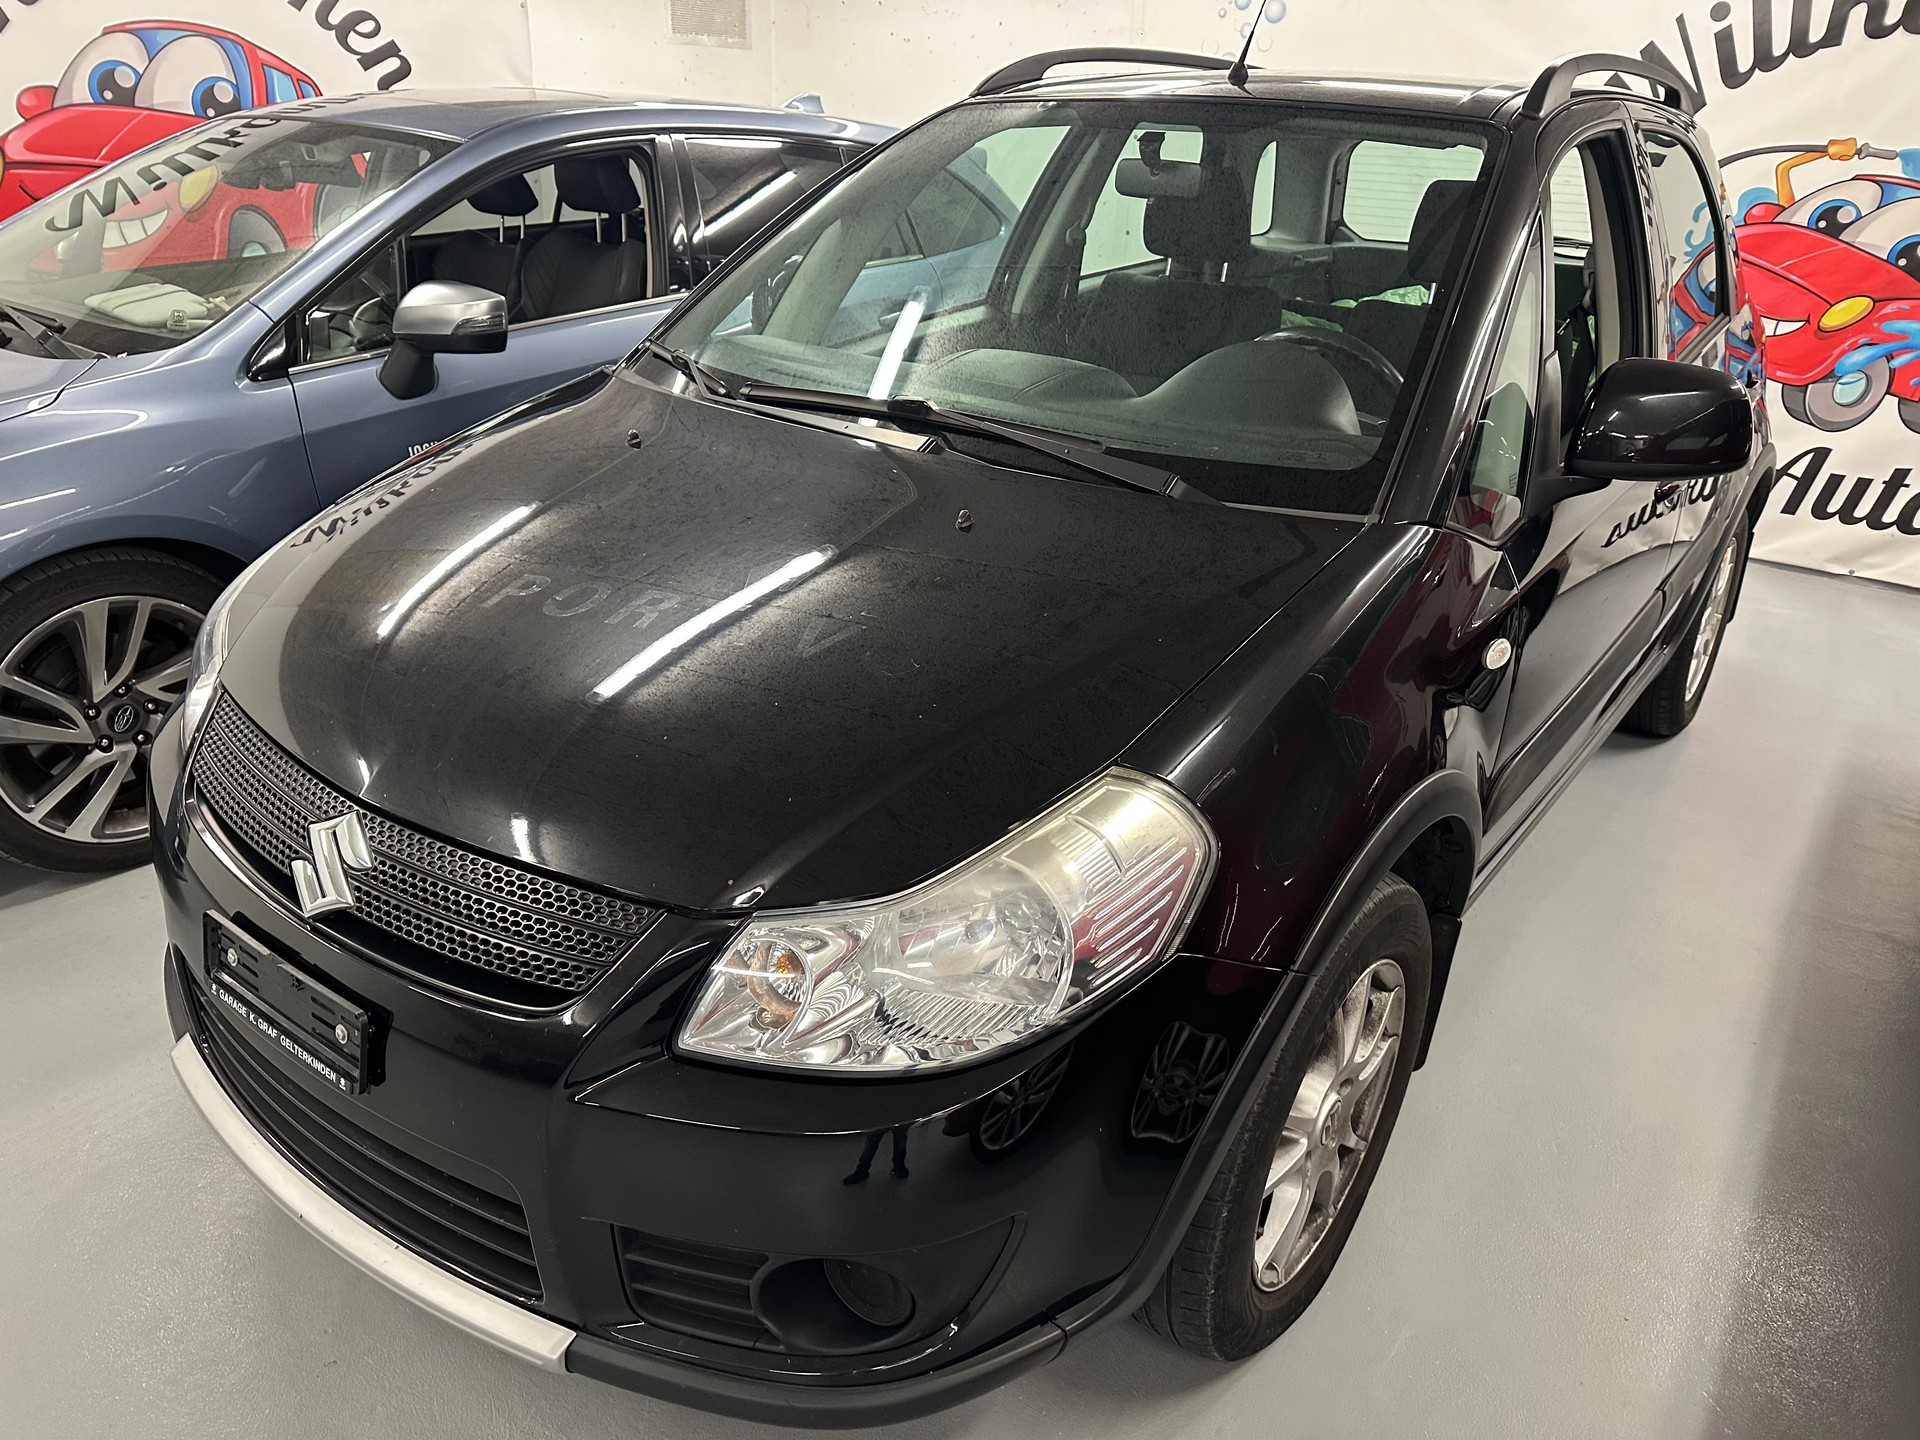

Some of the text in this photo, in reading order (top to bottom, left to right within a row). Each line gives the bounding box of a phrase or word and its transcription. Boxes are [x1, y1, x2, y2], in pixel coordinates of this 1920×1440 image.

[219, 989, 247, 1018] GARAGE
[257, 1018, 278, 1039] GRAF
[280, 1034, 337, 1083] GELTERKINDEN
